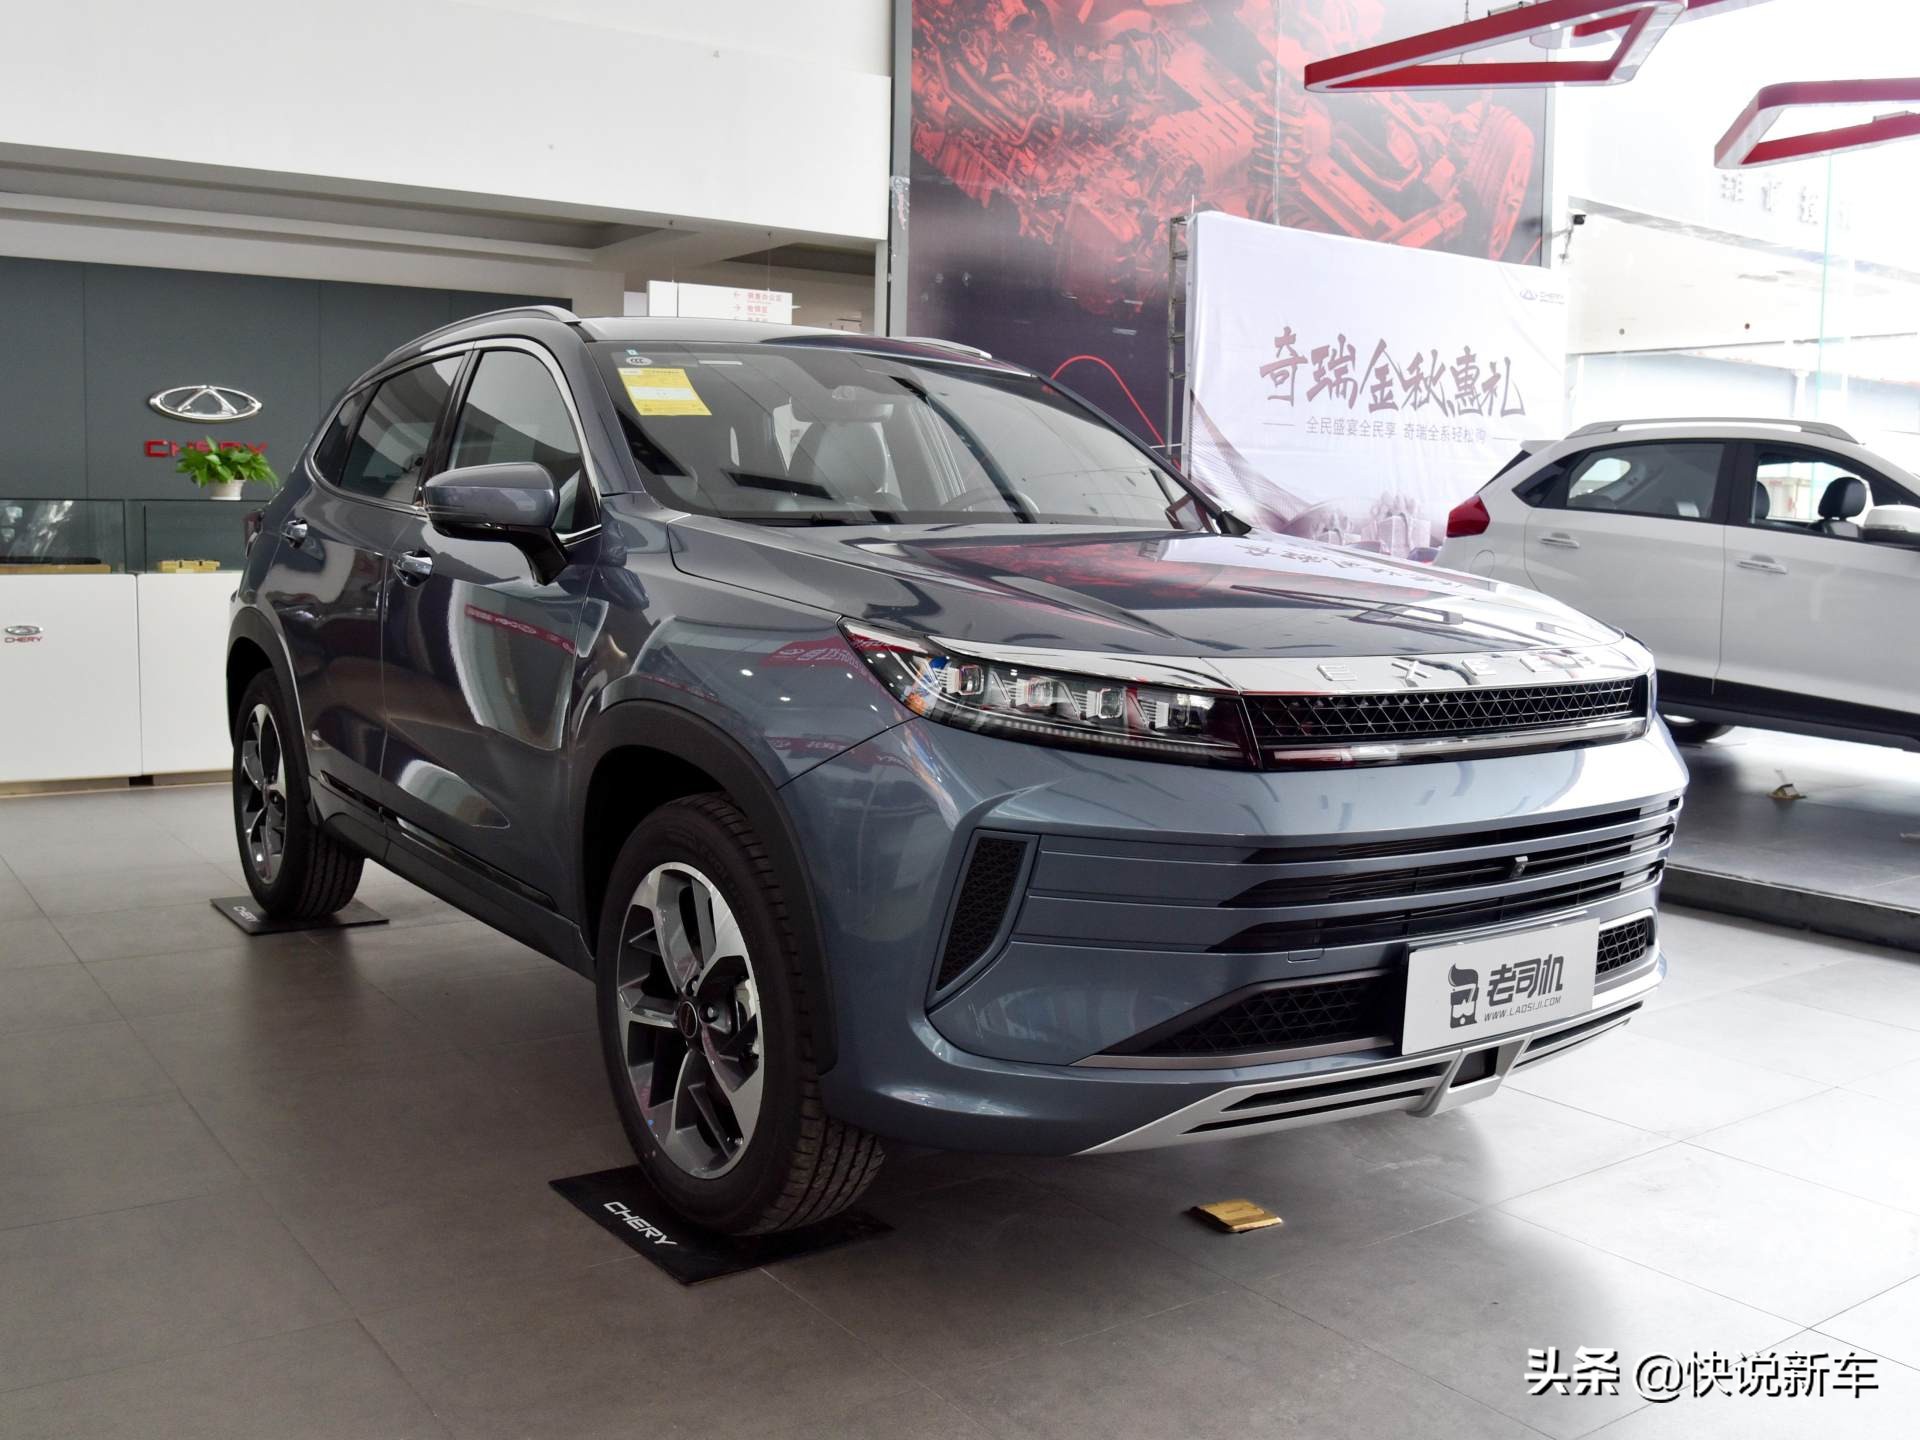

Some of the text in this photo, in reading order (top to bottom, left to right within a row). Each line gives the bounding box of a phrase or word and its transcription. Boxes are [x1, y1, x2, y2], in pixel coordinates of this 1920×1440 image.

[1259, 326, 1526, 418] 奇瑞金秋惠礼
[1306, 416, 1397, 438] 全民盛宴全民享
[1487, 954, 1564, 1007] 老司机
[1484, 995, 1562, 1022] WWW.LAOSIJI.COM
[603, 1201, 678, 1245] CHERY
